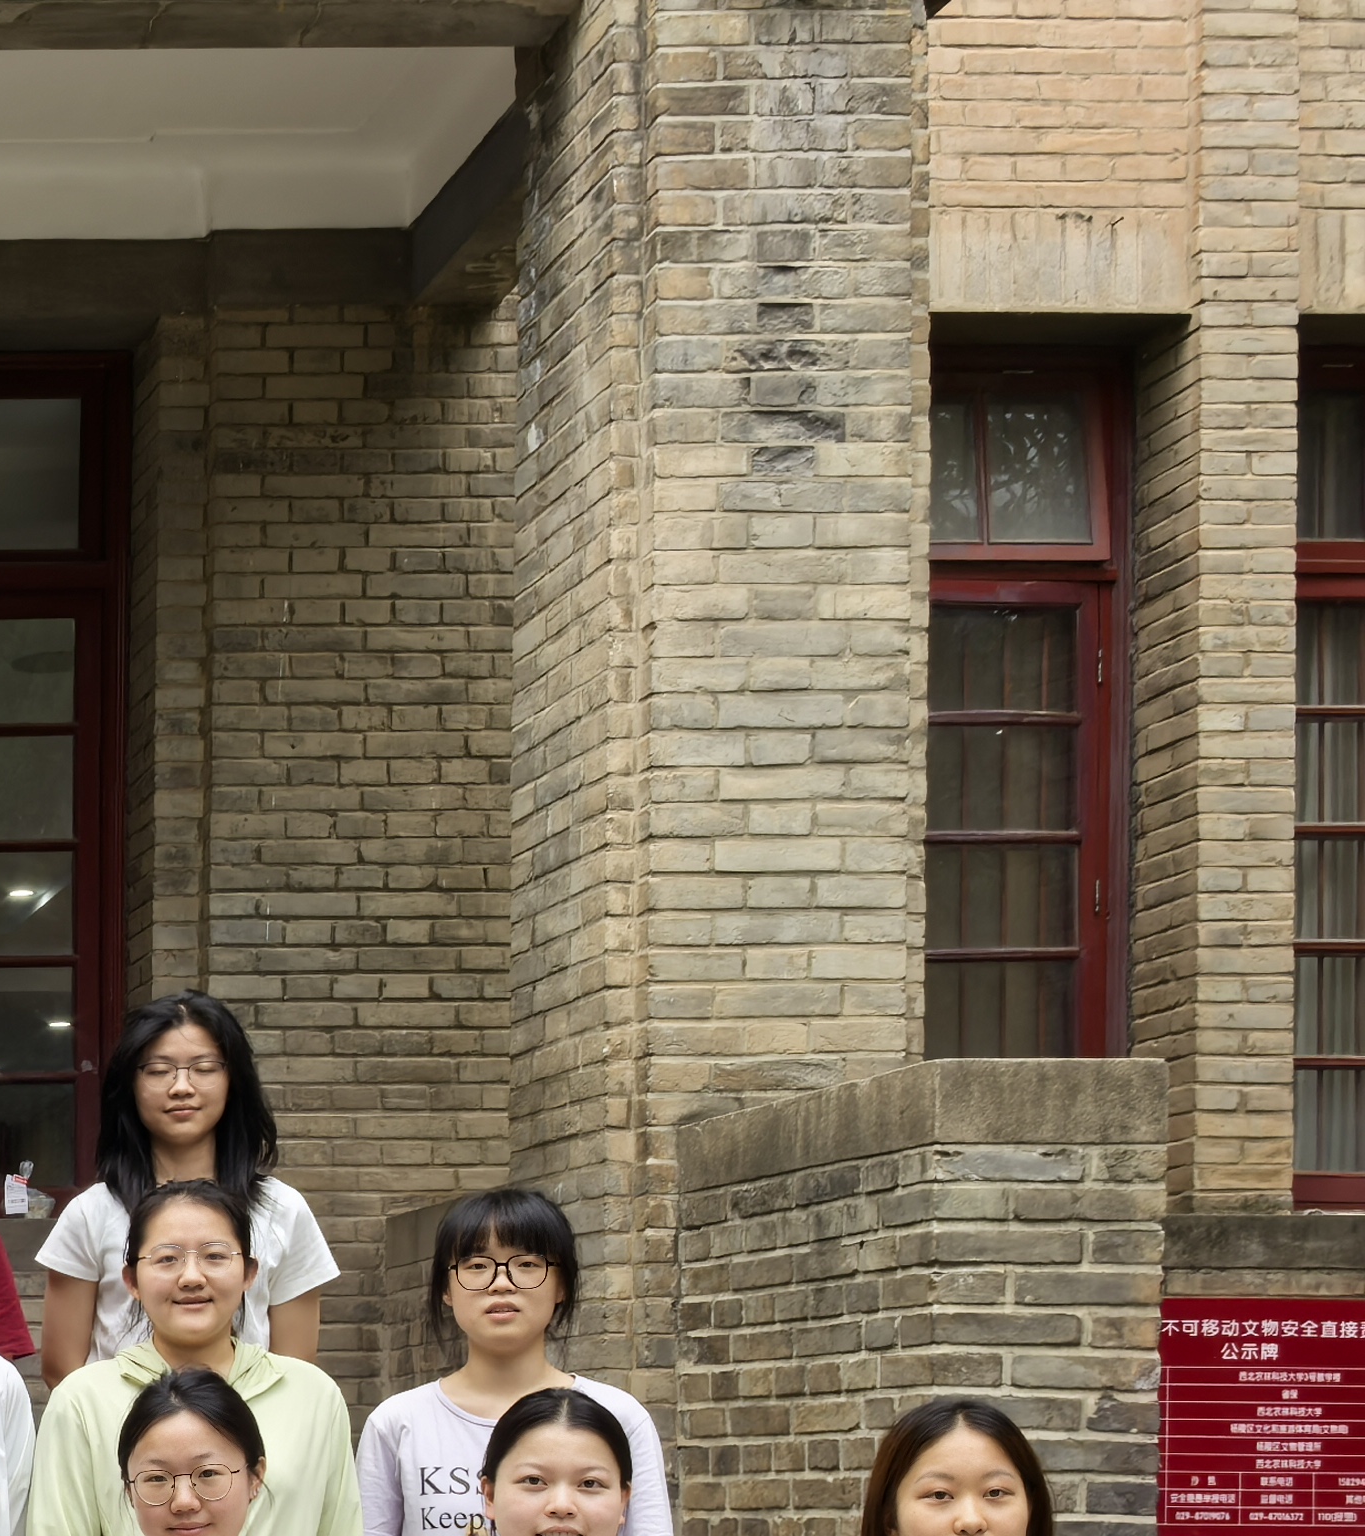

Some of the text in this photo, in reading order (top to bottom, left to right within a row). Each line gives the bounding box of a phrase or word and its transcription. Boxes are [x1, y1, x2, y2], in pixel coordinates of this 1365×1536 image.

[1161, 1318, 1365, 1339] 不可移动文物安全直接
[1220, 1342, 1280, 1361] 公示牌
[420, 1506, 486, 1536] Keep
